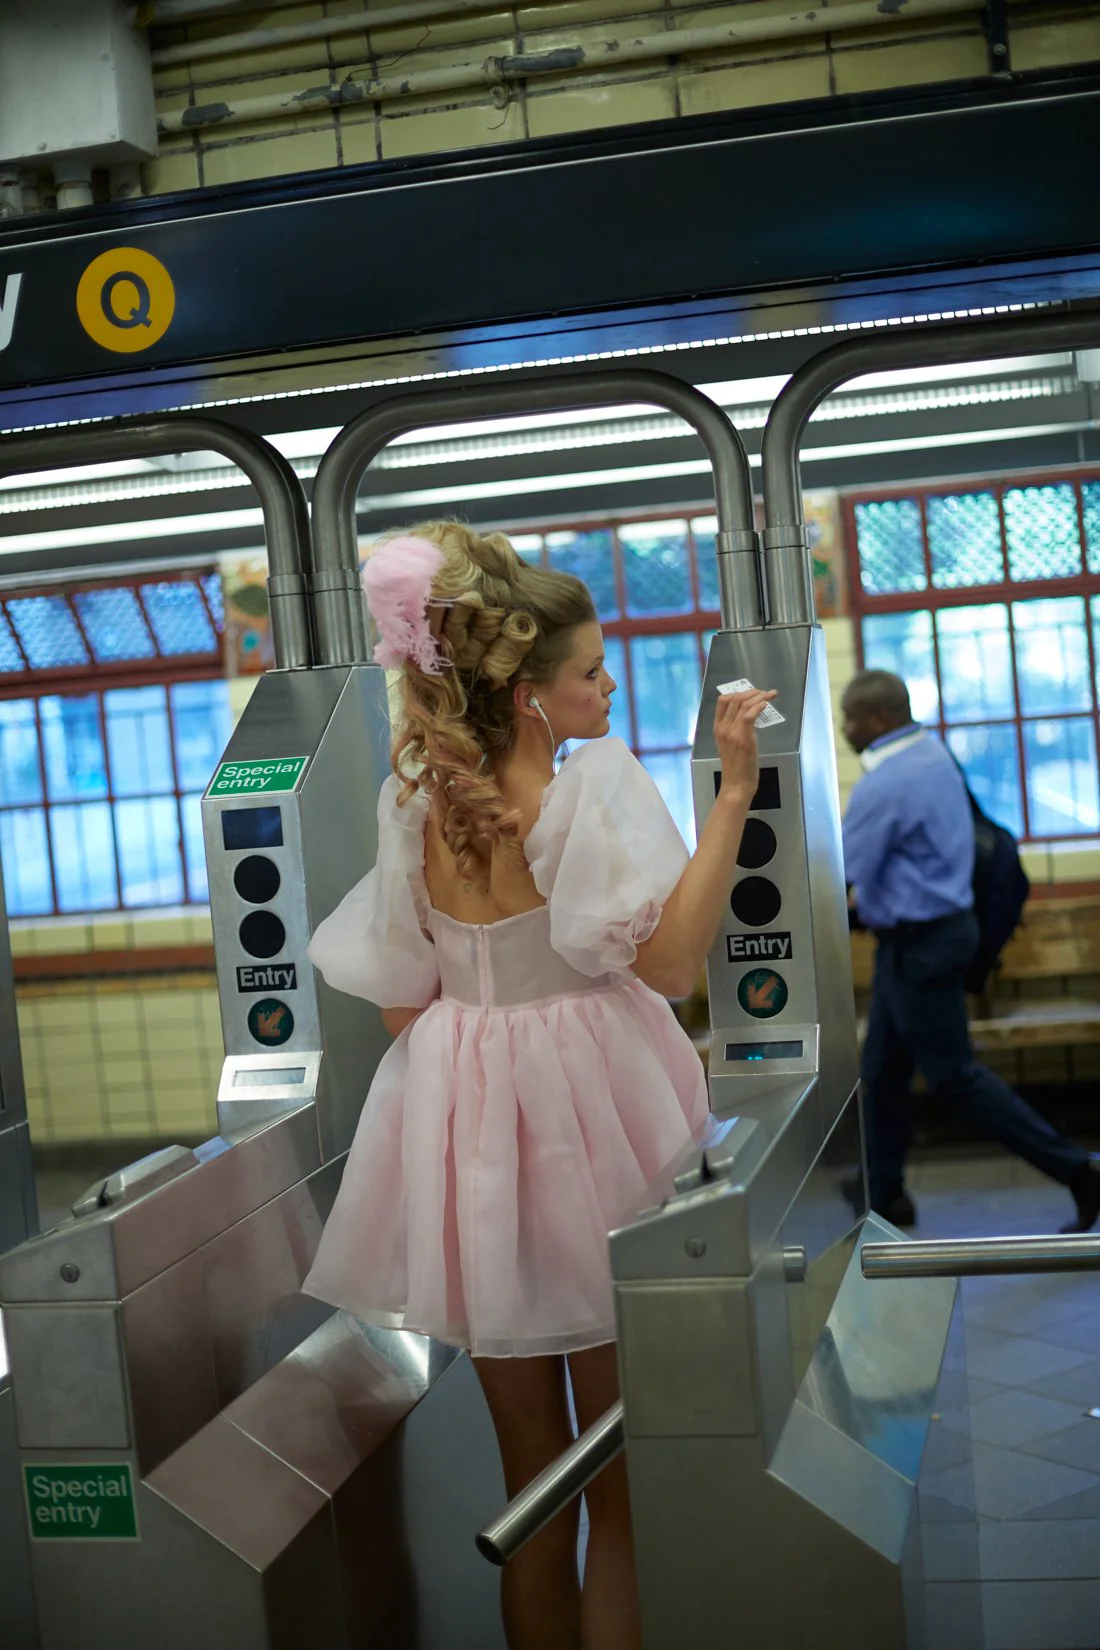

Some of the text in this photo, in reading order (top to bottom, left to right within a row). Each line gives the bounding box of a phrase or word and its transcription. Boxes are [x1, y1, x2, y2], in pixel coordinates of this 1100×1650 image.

[100, 271, 152, 328] Q
[222, 761, 301, 779] Special
[217, 777, 272, 789] entry
[729, 935, 790, 958] Entry
[239, 966, 295, 988] Entry
[32, 1475, 128, 1503] Special
[35, 1502, 101, 1528] entry
